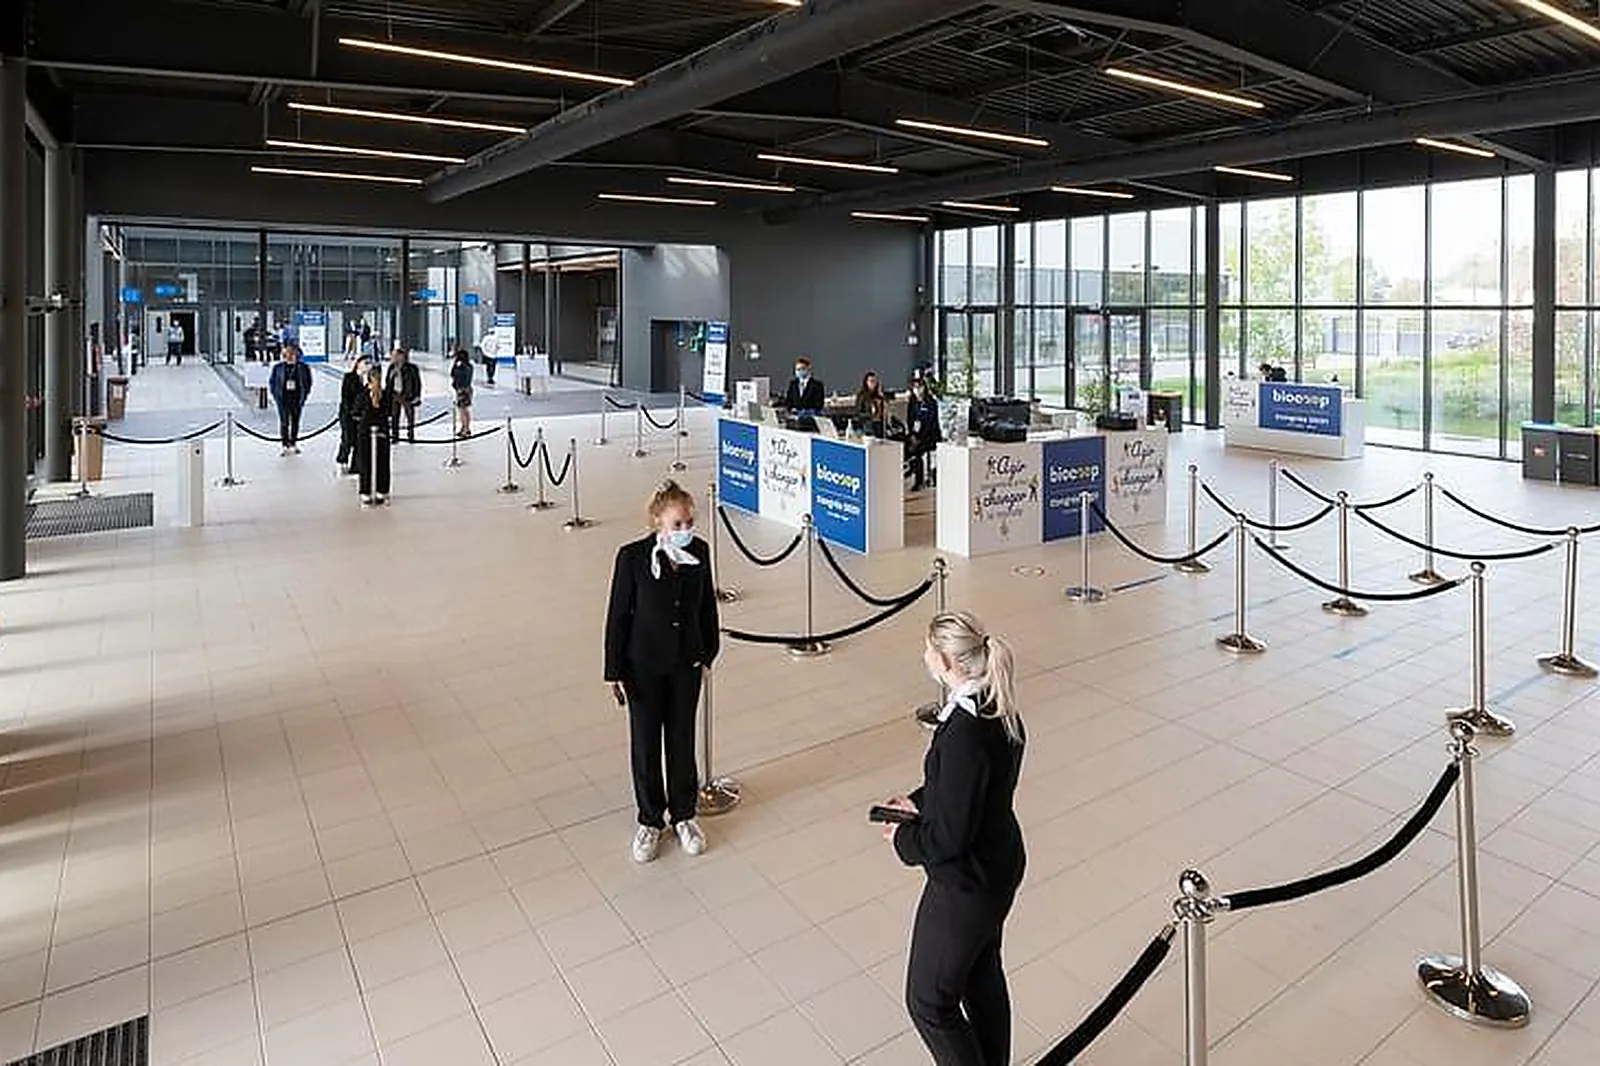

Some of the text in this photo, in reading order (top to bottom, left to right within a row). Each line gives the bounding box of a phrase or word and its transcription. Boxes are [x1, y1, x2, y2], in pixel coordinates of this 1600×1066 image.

[1272, 389, 1330, 408] biocoop
[816, 462, 860, 495] biocoop
[1049, 465, 1099, 482] biocoop
